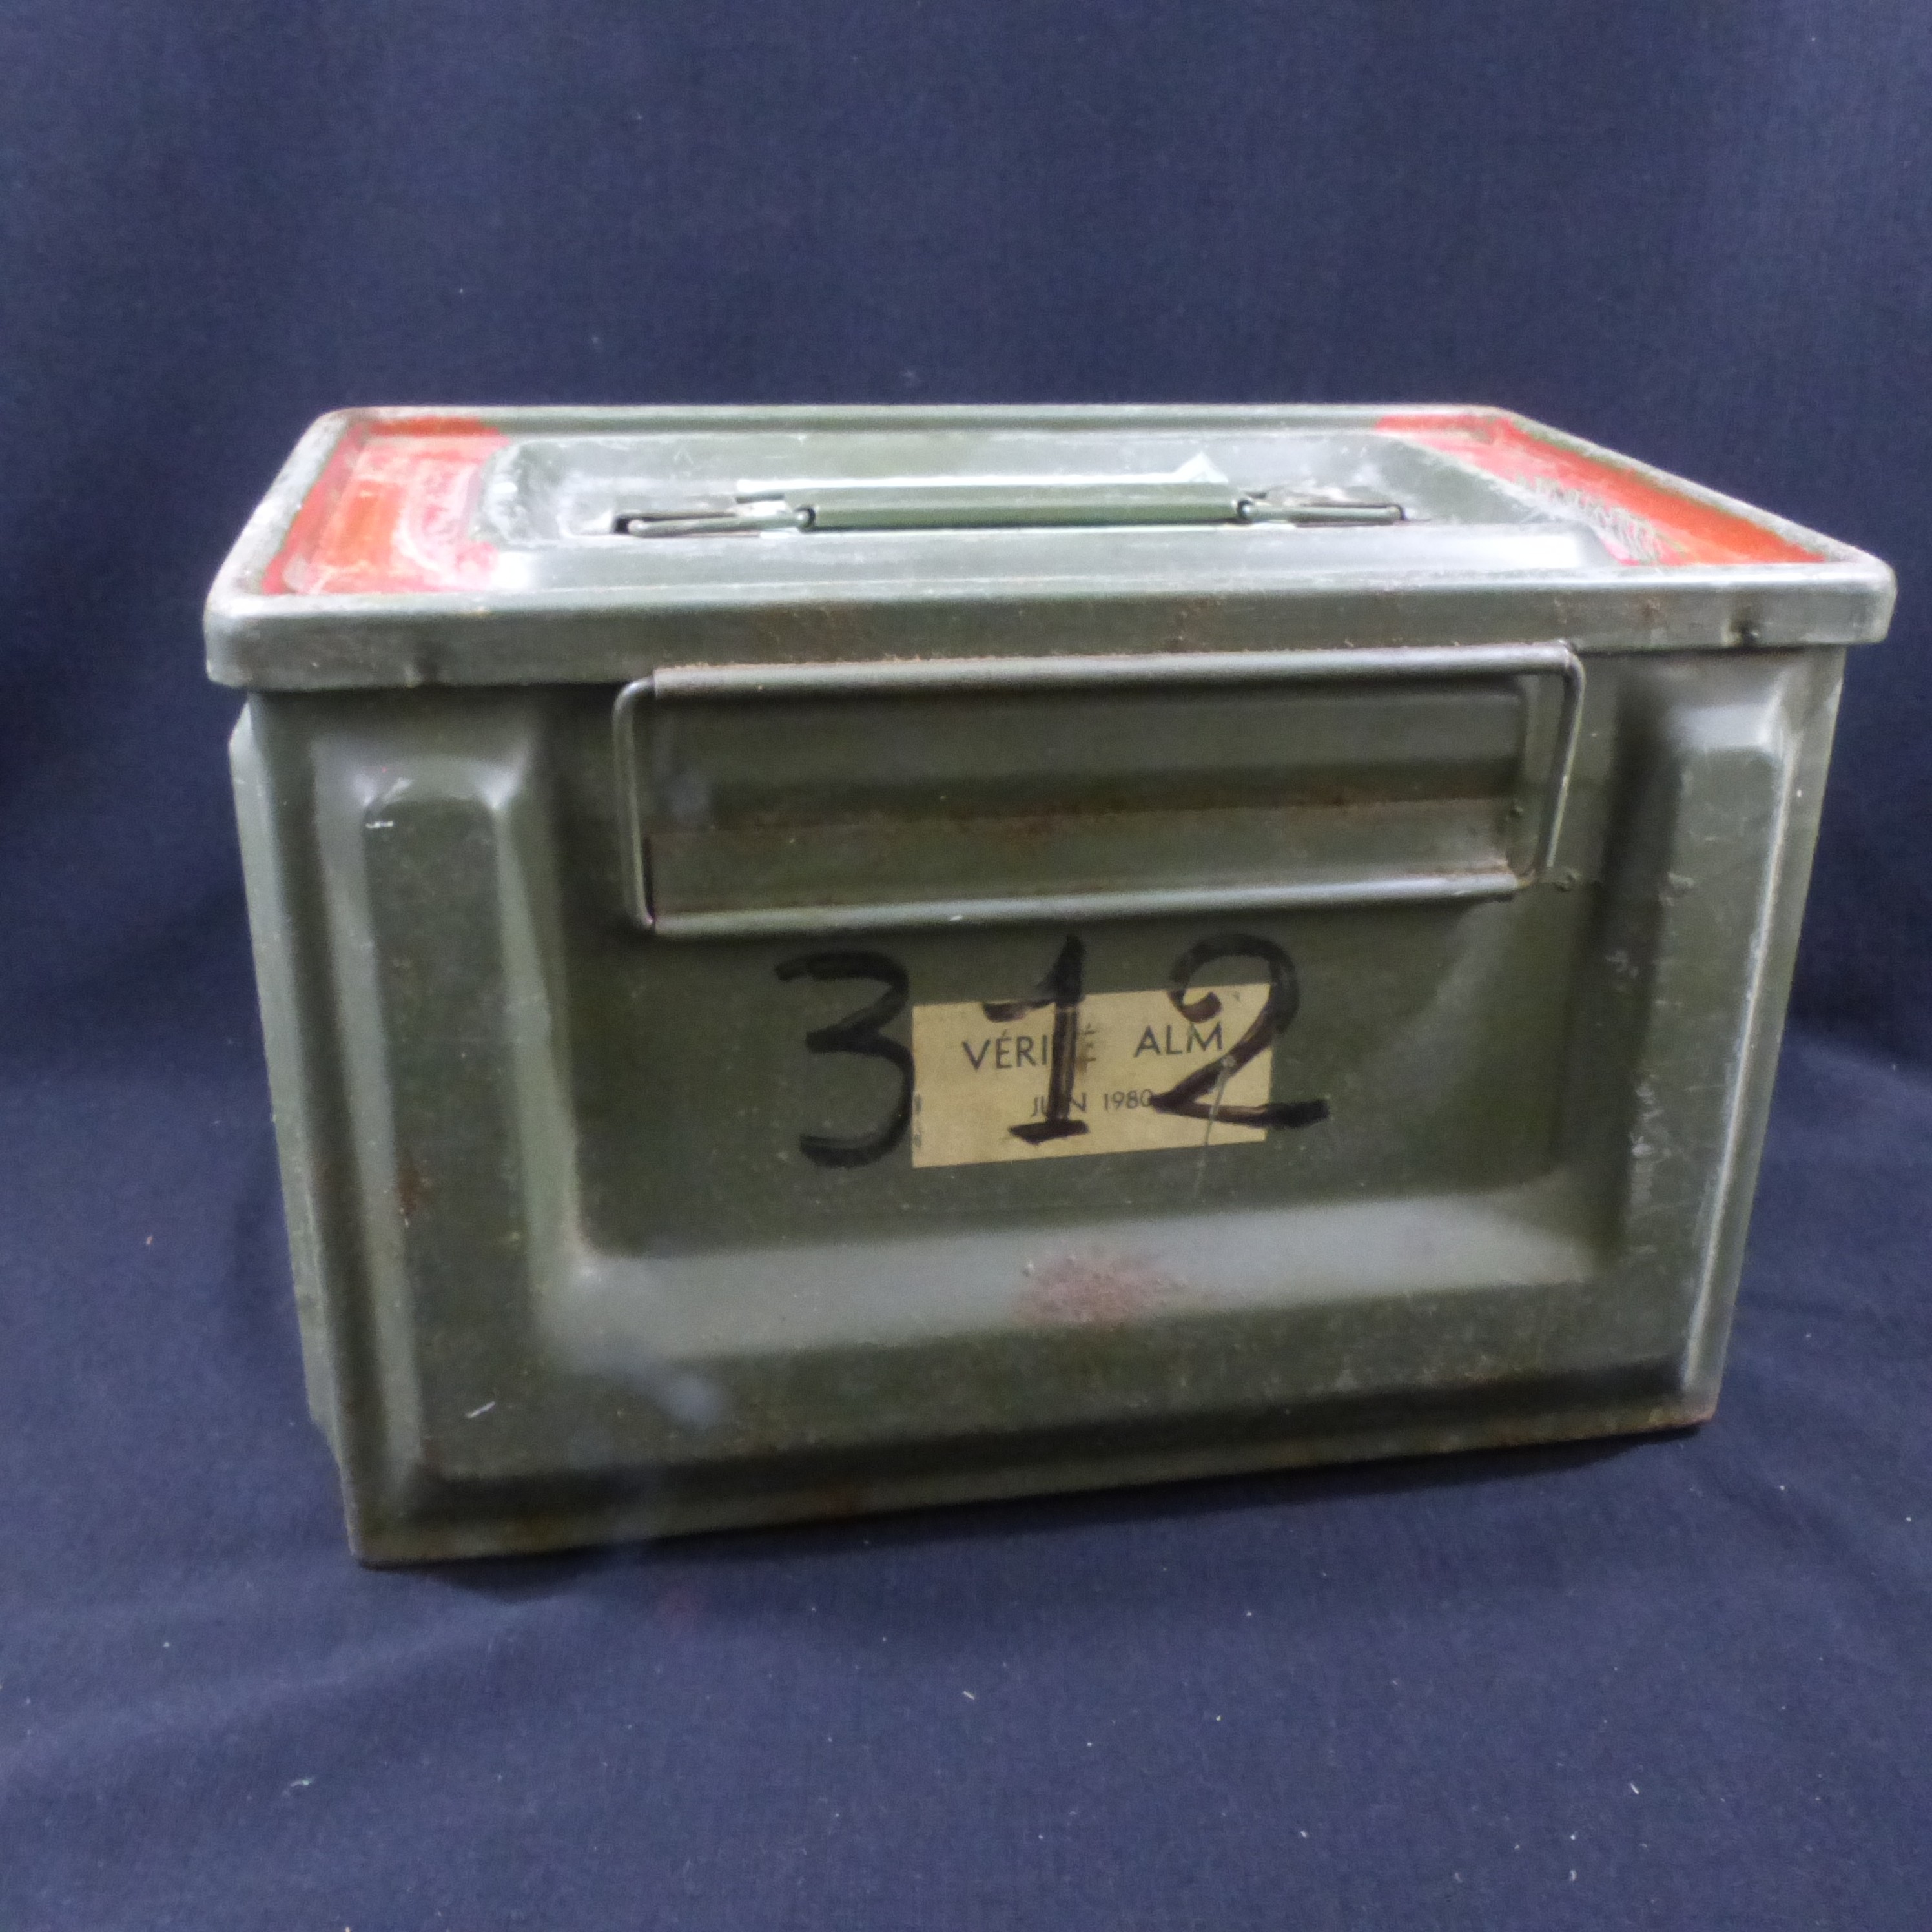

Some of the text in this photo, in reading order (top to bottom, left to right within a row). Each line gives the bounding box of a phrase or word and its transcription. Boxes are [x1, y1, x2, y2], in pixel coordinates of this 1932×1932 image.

[1134, 1022, 1222, 1058] ALM
[1031, 1089, 1153, 1117] JUN 1980
